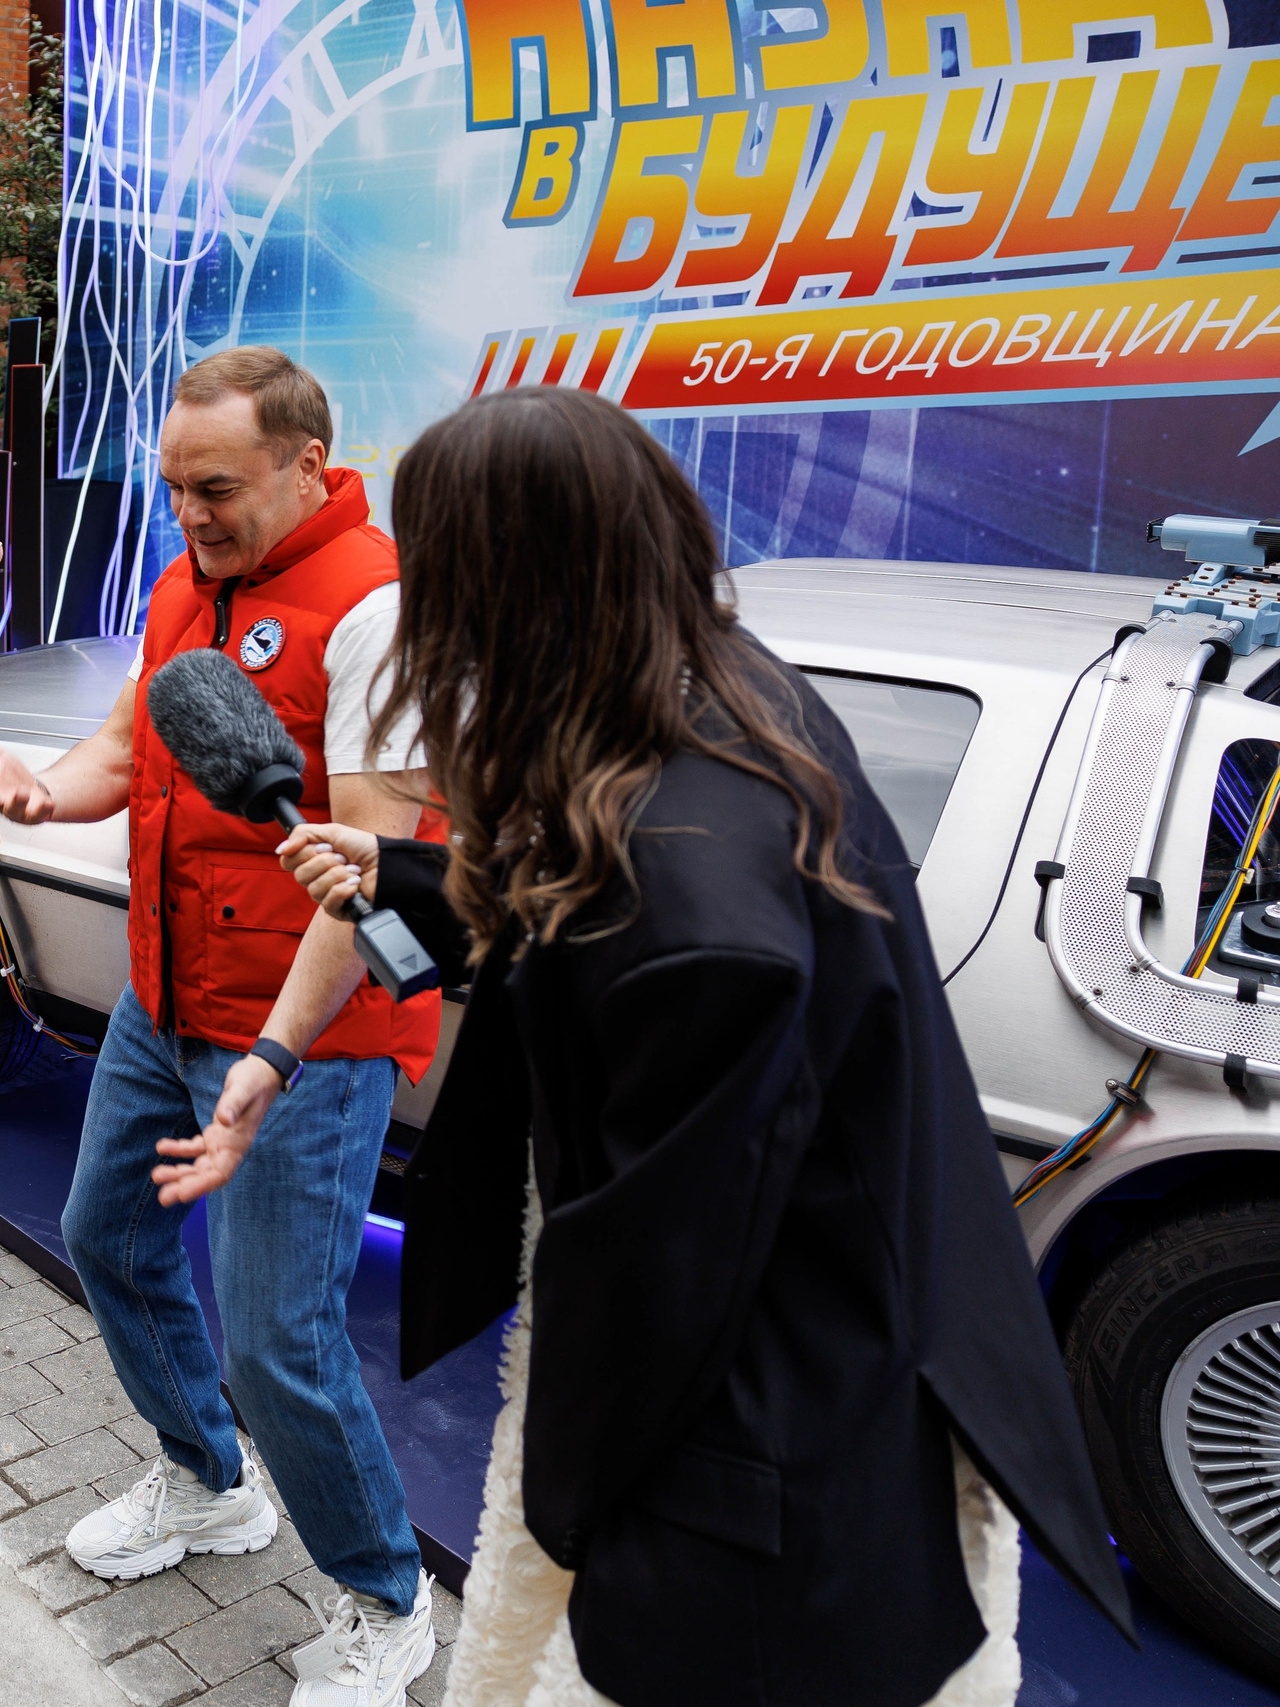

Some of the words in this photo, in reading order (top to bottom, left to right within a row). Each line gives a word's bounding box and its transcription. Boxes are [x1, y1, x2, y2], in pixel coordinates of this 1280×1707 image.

[462, 0, 1215, 122] НАЗ
[509, 125, 579, 220] В
[572, 58, 1280, 306] БУДУЩЕ
[682, 333, 815, 387] 50-Я
